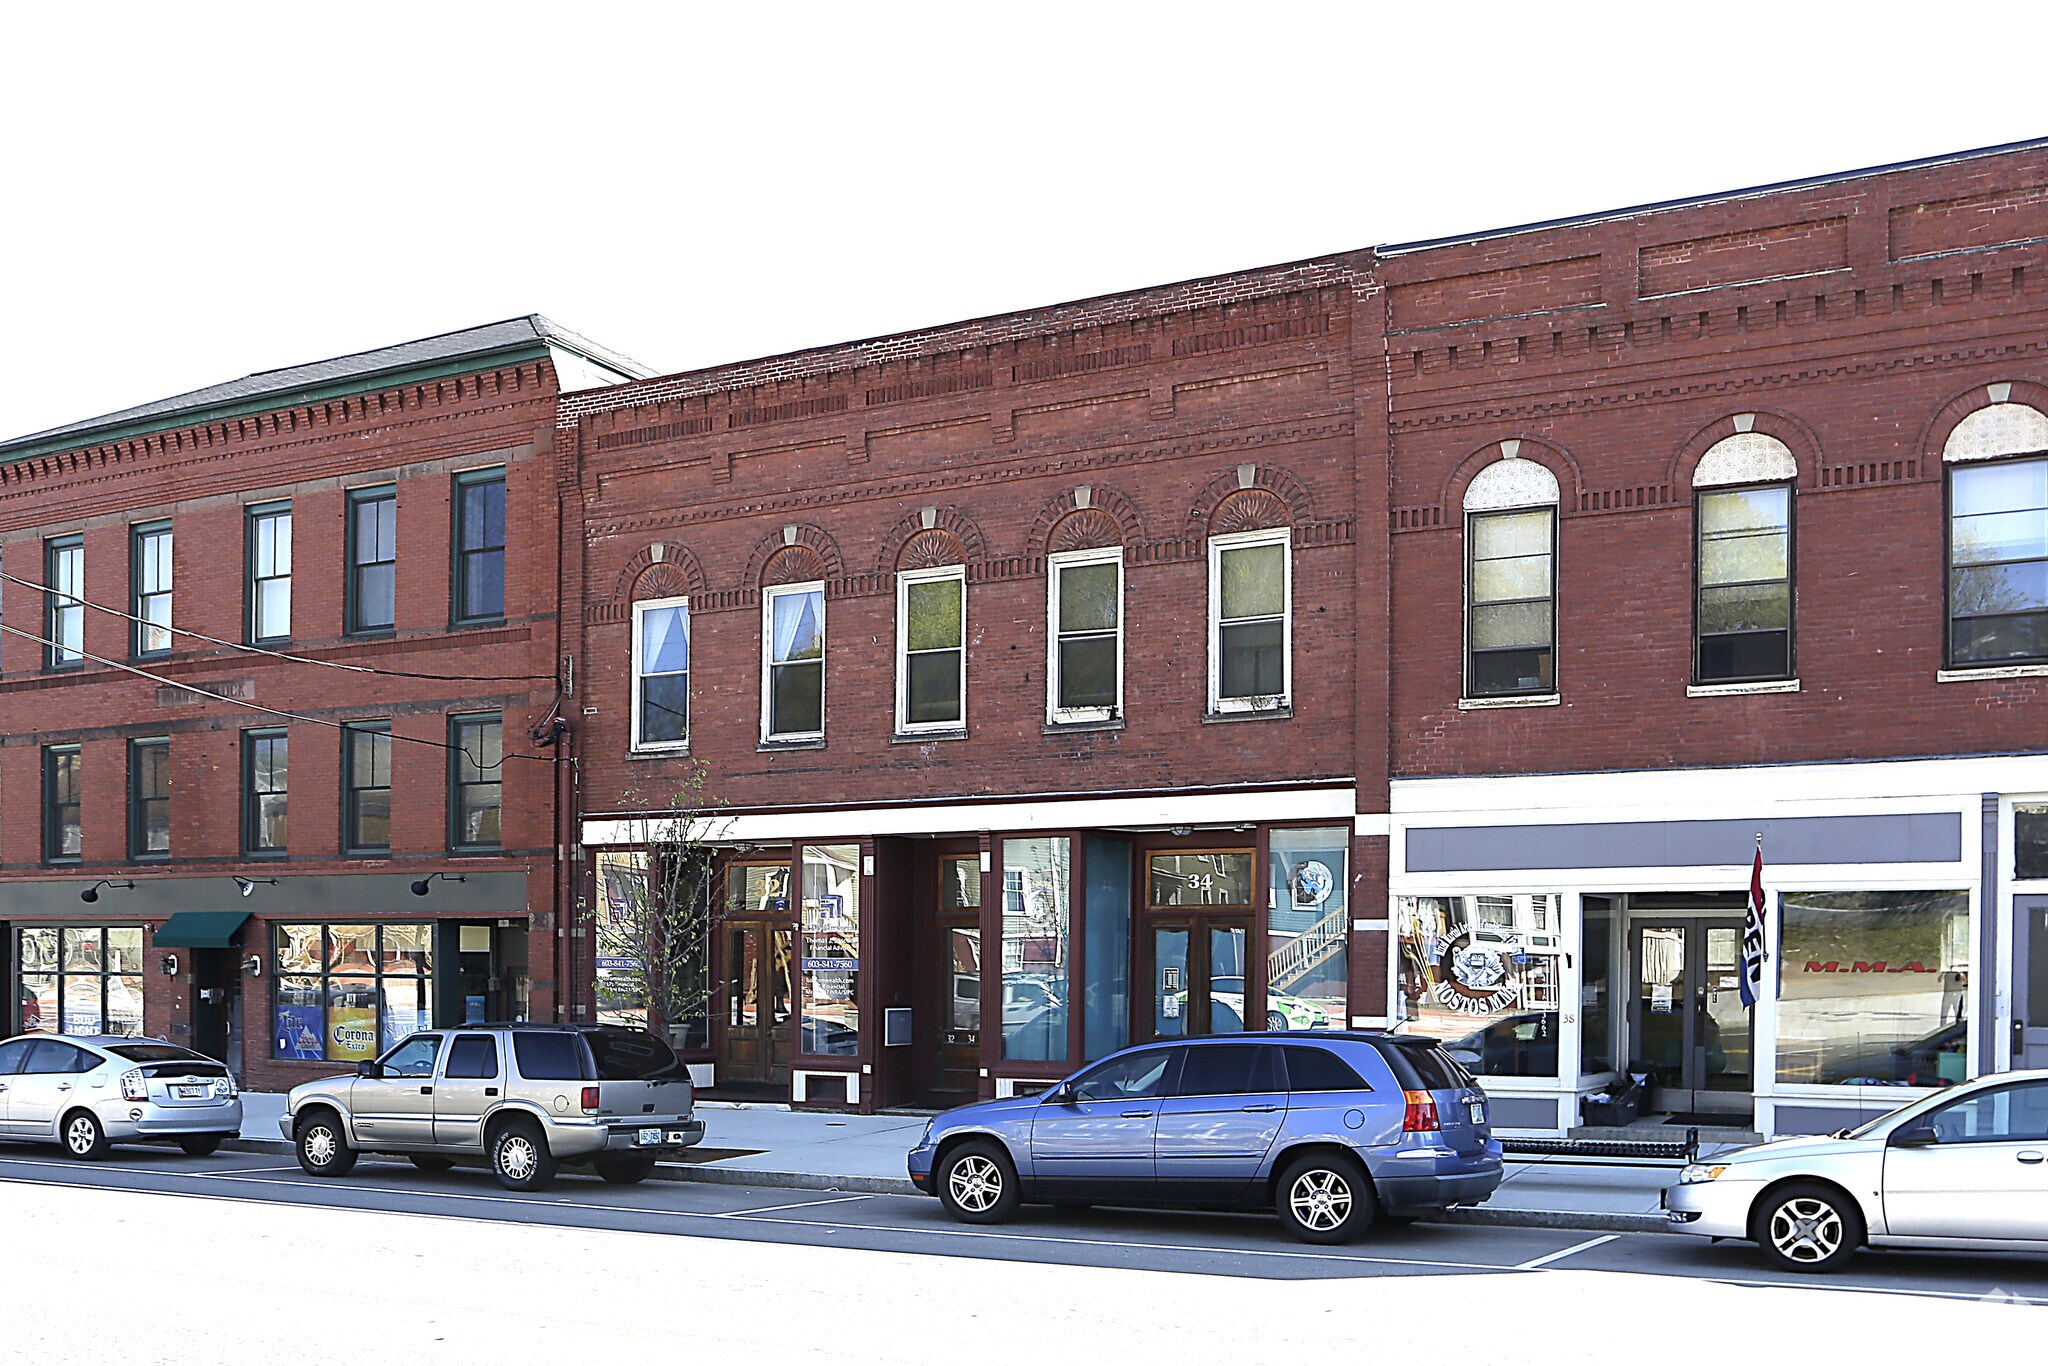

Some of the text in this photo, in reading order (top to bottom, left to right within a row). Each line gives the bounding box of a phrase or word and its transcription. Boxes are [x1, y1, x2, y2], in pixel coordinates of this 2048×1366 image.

[753, 879, 780, 897] 32
[1188, 874, 1213, 889] 34
[1804, 961, 1937, 973] M.M.A.
[1434, 980, 1490, 1017] NOSTOS
[334, 1025, 375, 1045] Corona
[346, 1041, 365, 1051] Extra
